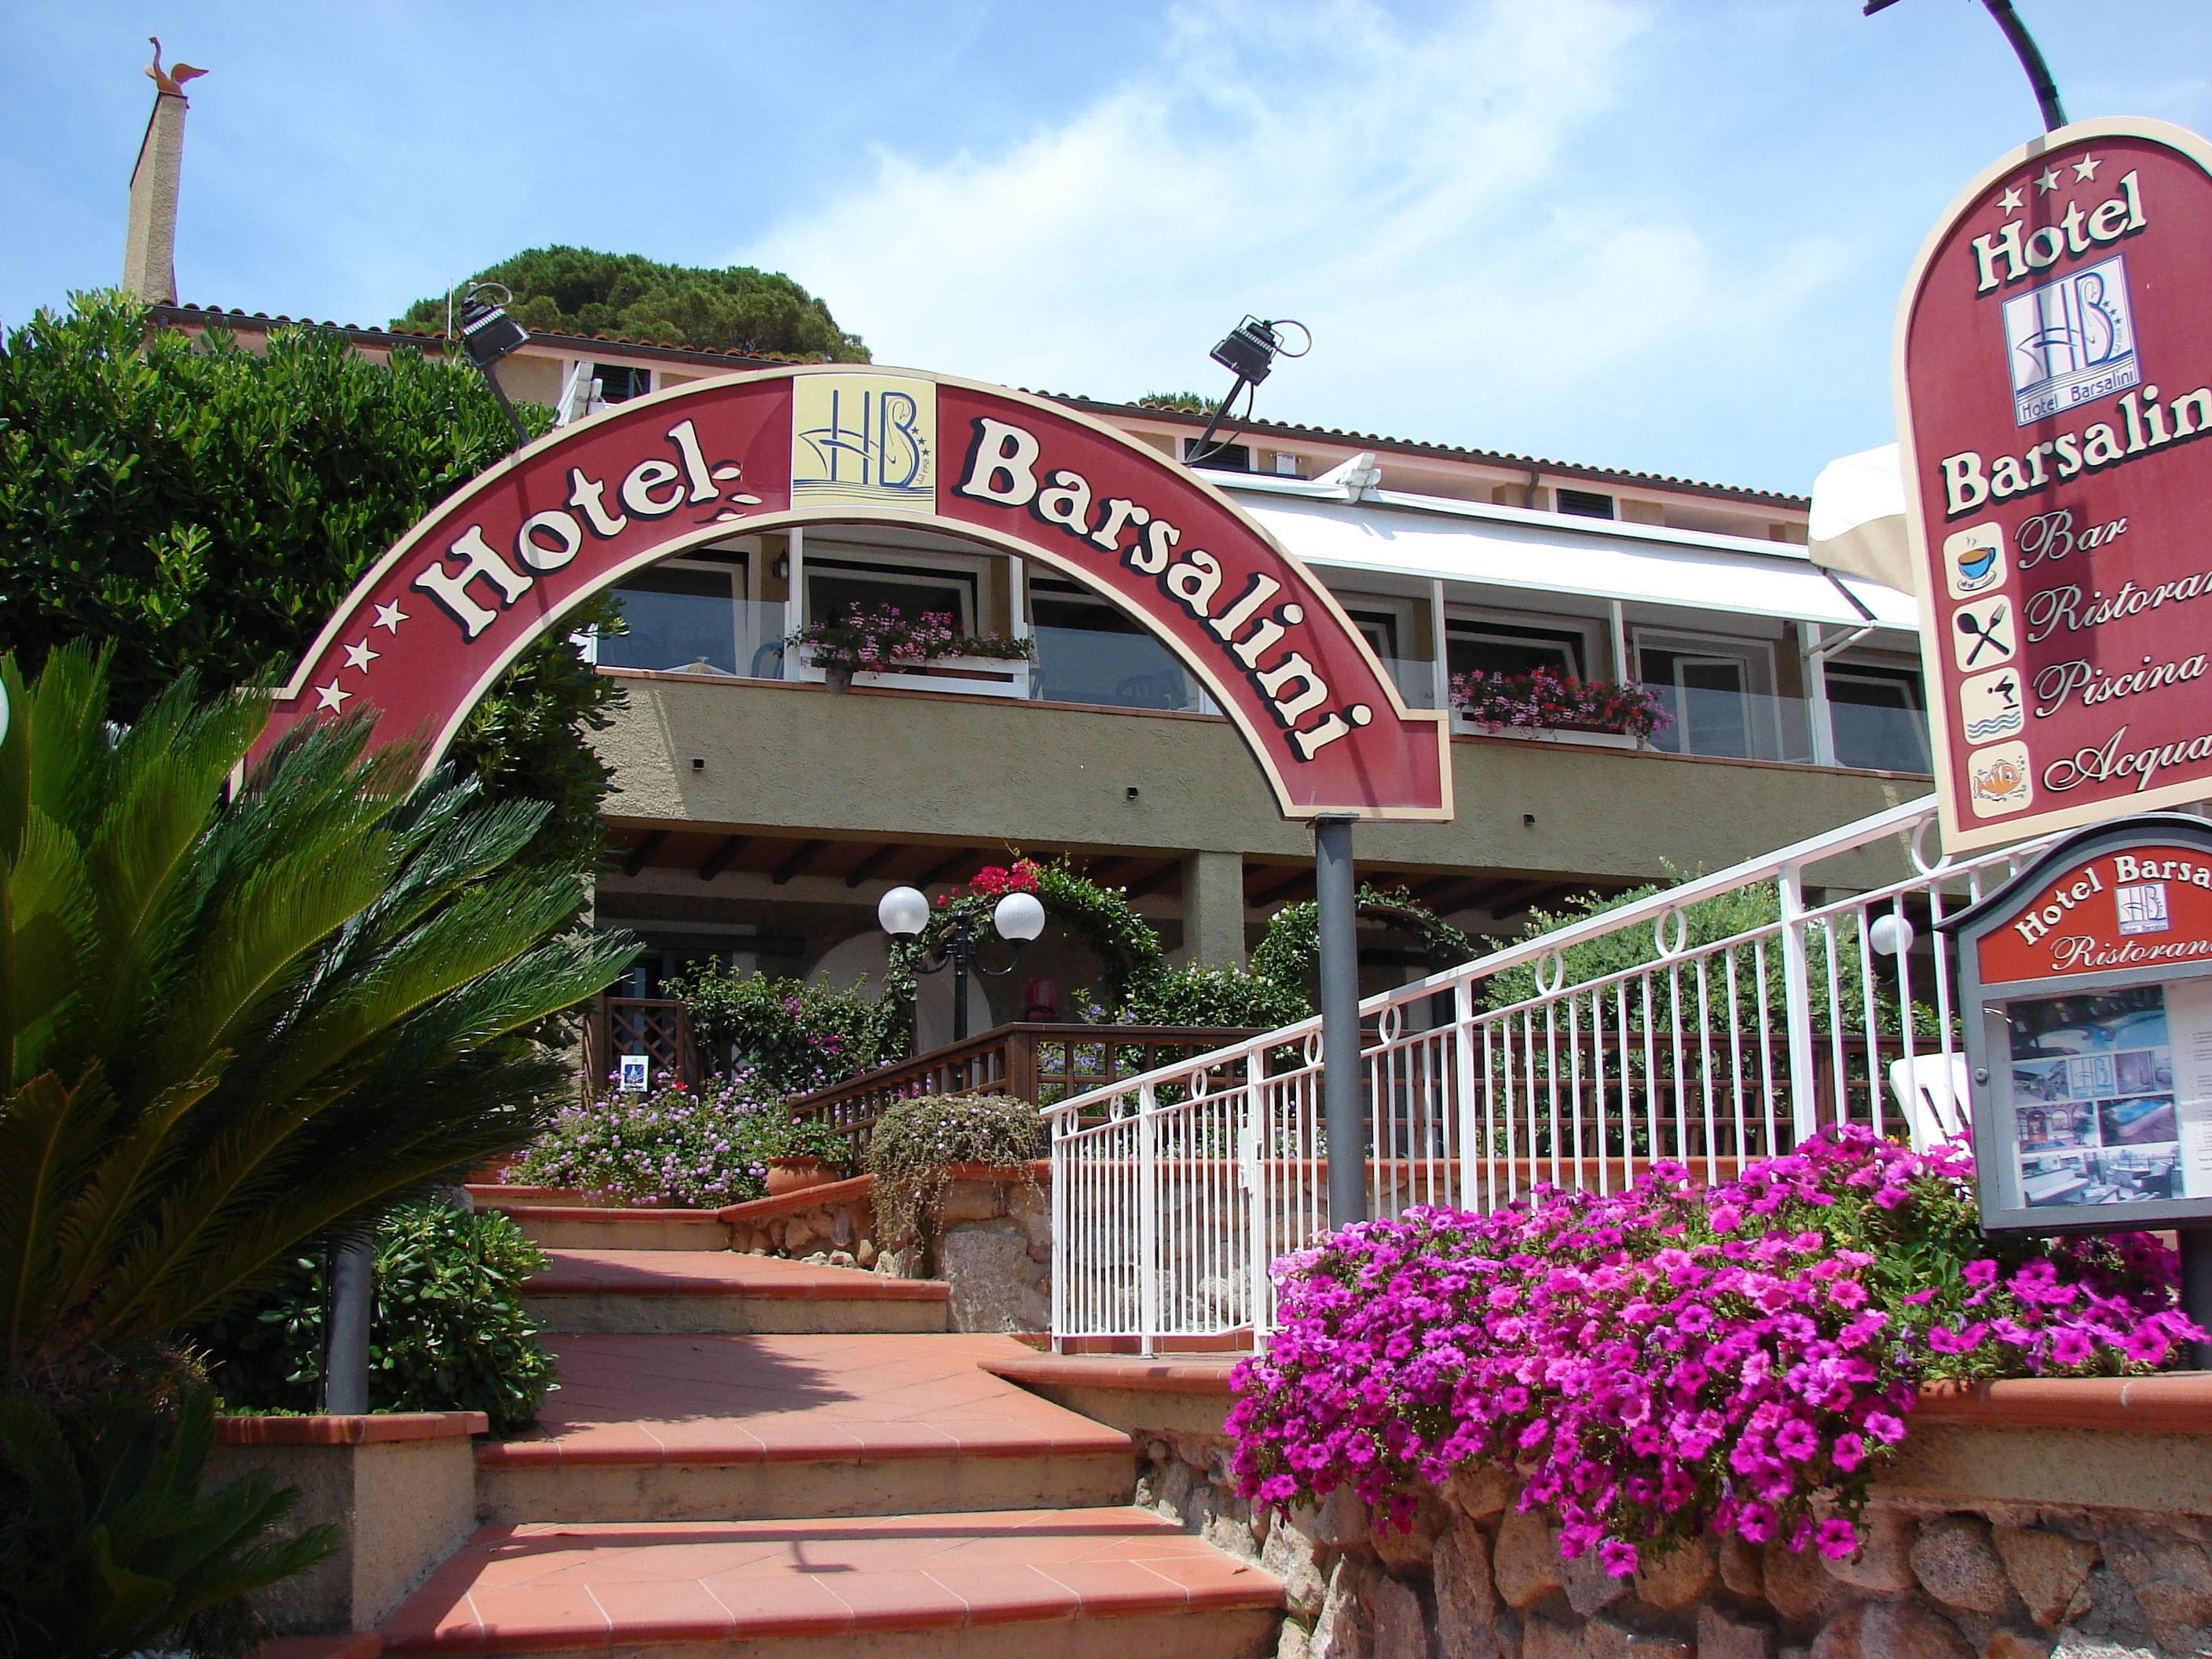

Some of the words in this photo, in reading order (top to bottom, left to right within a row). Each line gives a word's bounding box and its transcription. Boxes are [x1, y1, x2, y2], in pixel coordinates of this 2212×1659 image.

[1972, 169, 2147, 292] Hotel
[2022, 393, 2058, 420] Hotel
[2070, 365, 2134, 403] Barsalini
[2013, 507, 2130, 569] Bar
[412, 419, 720, 639] Hotel
[960, 417, 1372, 763] Barsalini
[2033, 652, 2209, 717] Piscina
[2013, 866, 2104, 946] Hotel
[2113, 855, 2212, 890] Barsa
[2049, 935, 2212, 971] Ristoran
